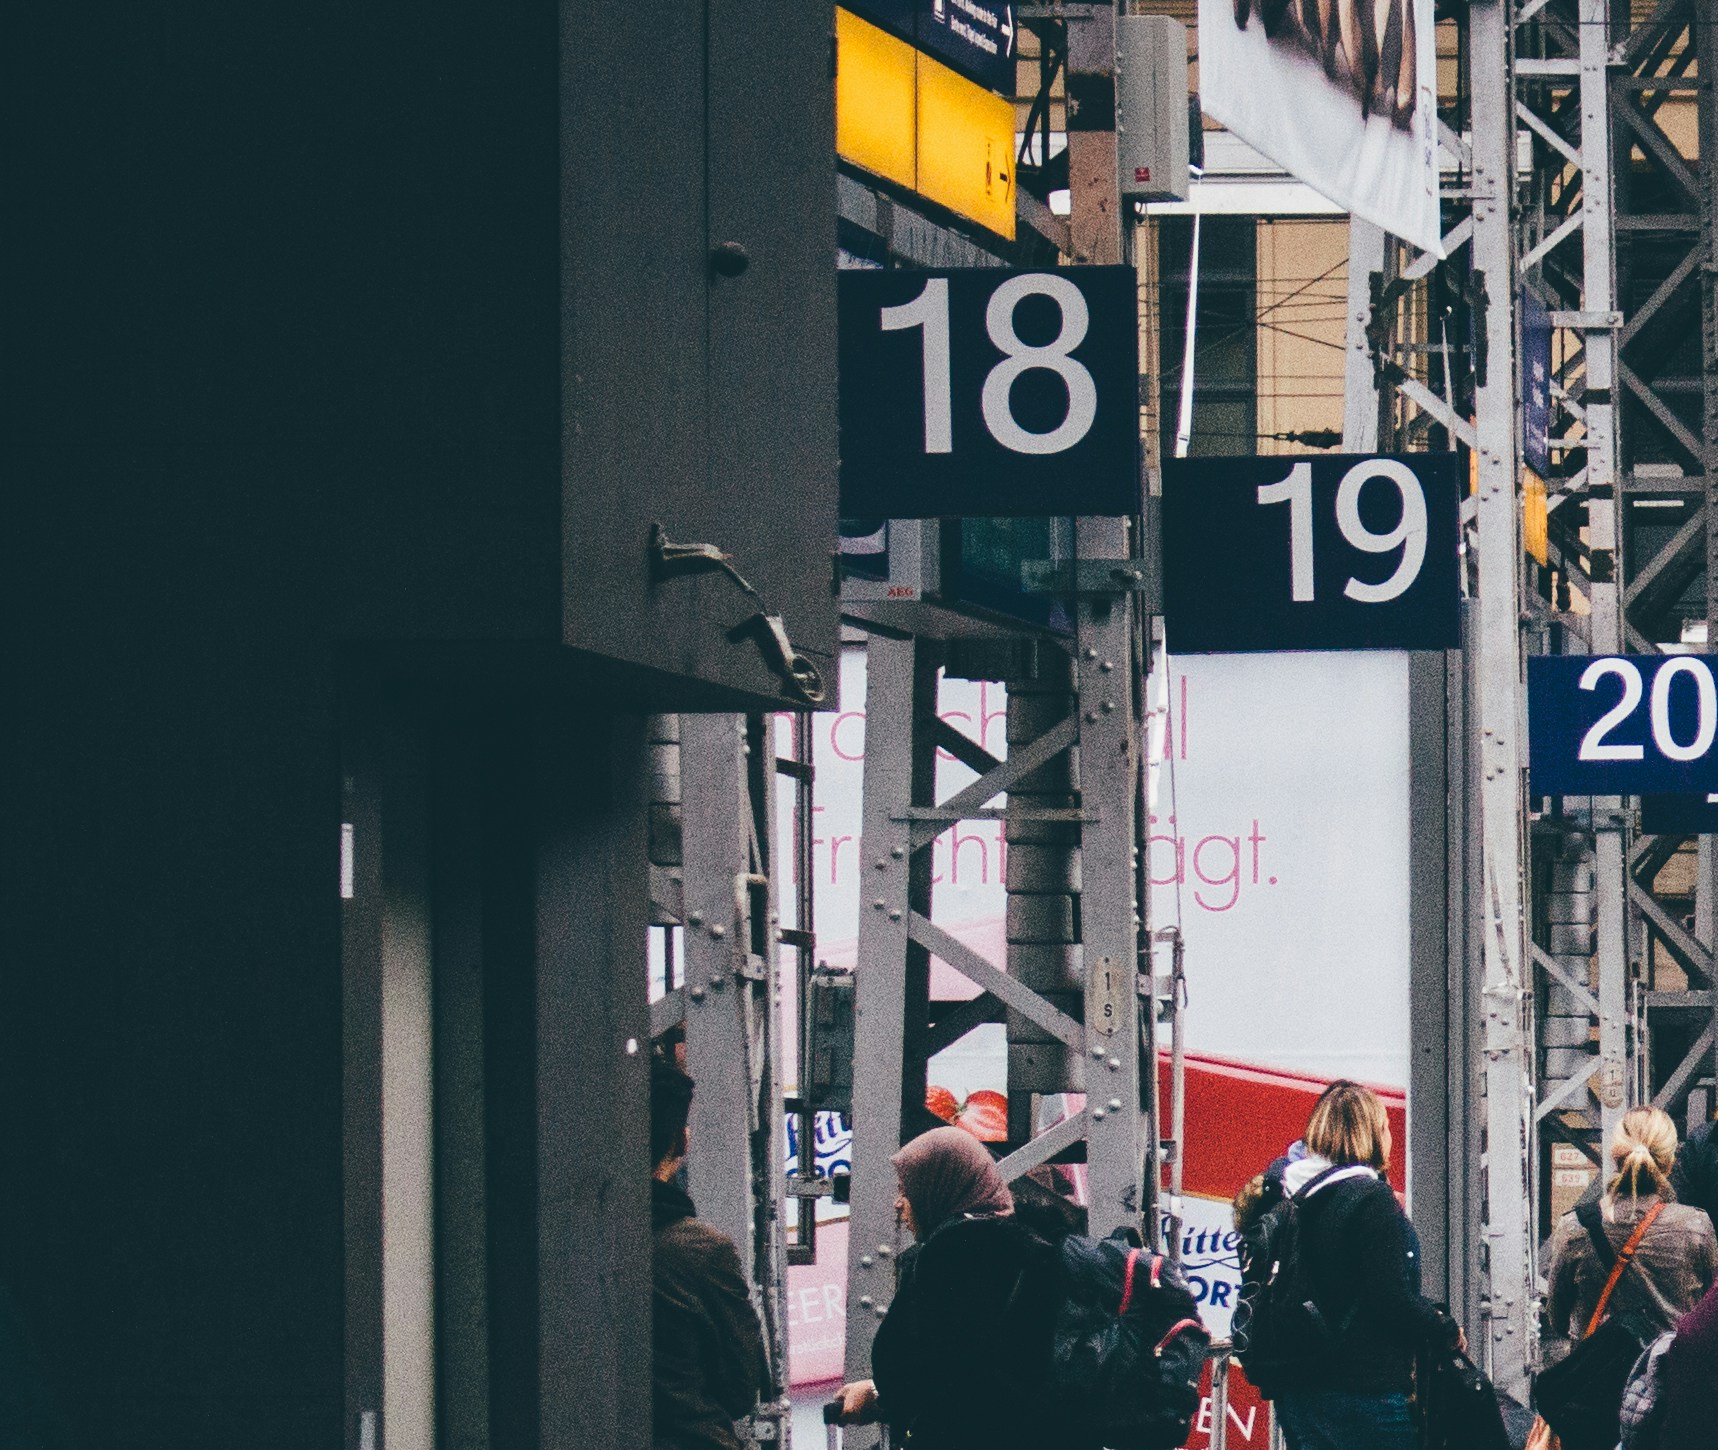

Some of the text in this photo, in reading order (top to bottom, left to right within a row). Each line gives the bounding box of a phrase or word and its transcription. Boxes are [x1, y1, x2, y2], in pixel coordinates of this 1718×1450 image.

[881, 273, 1097, 455] 18
[1257, 459, 1428, 602] 19
[1578, 656, 1718, 760] 20
[1161, 1212, 1241, 1256] Ritte
